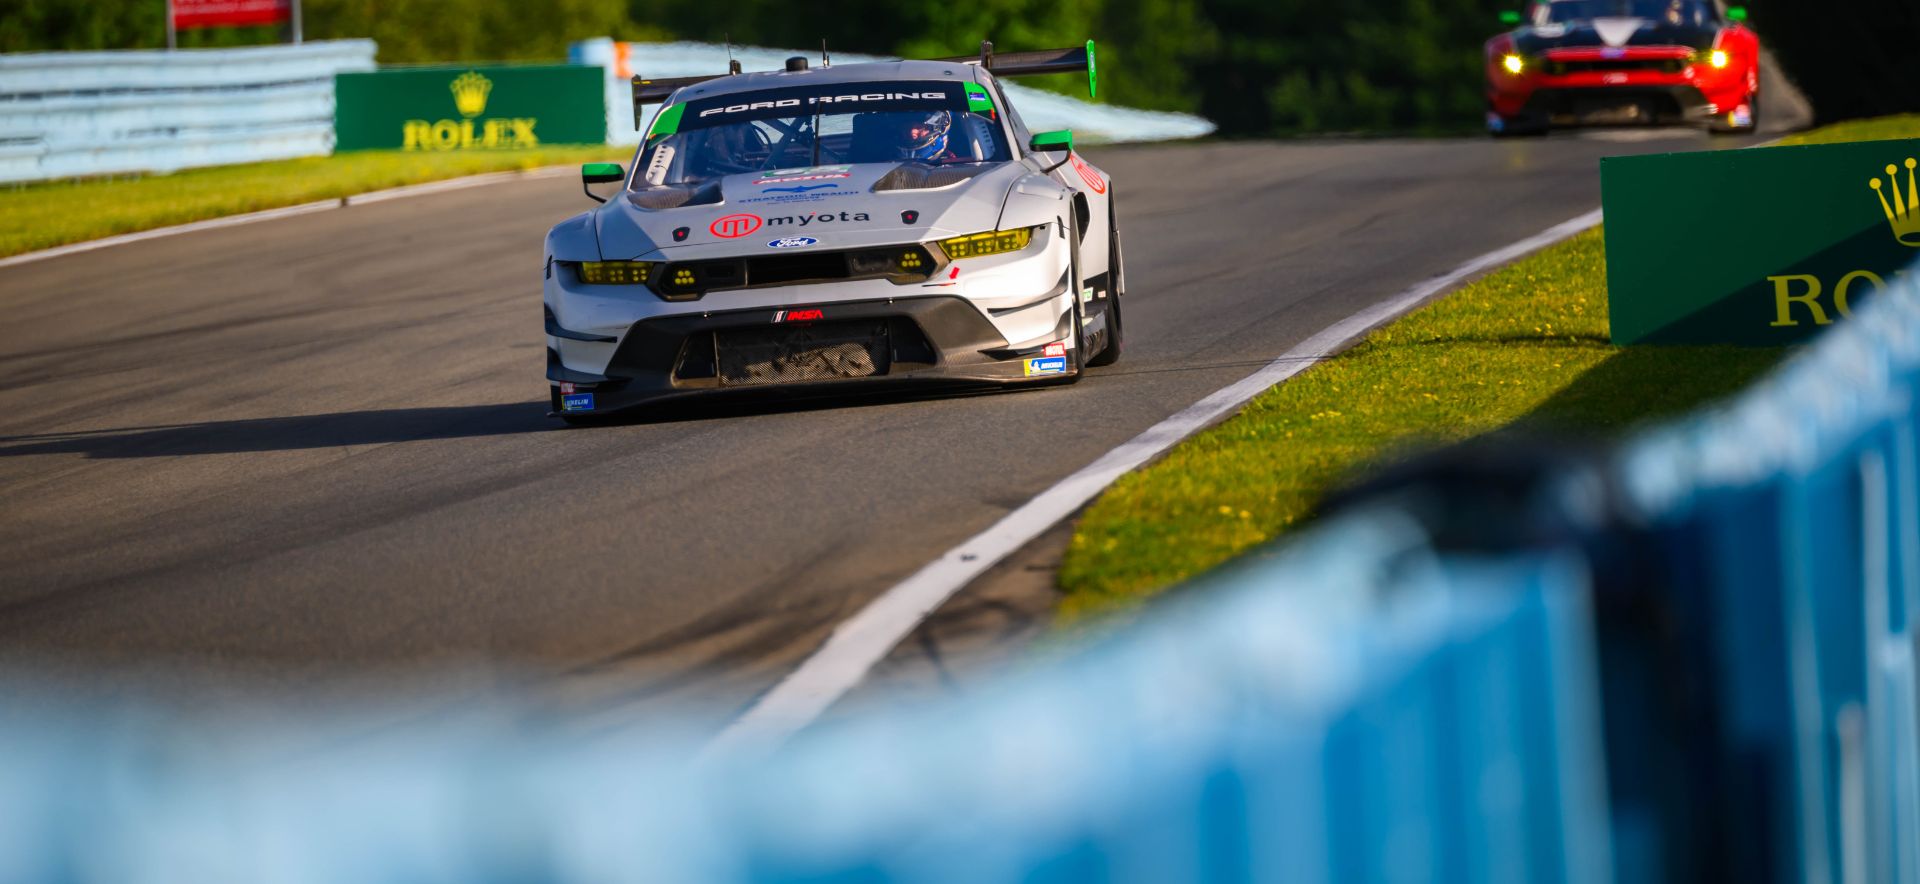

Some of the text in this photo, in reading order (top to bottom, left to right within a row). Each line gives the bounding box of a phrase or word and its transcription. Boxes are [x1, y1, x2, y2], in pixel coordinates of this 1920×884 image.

[700, 92, 946, 117] FORD RACING
[403, 118, 538, 150] ROLEX
[767, 211, 870, 227] myota
[1767, 270, 1906, 327] RO
[787, 310, 824, 321] IMSA
